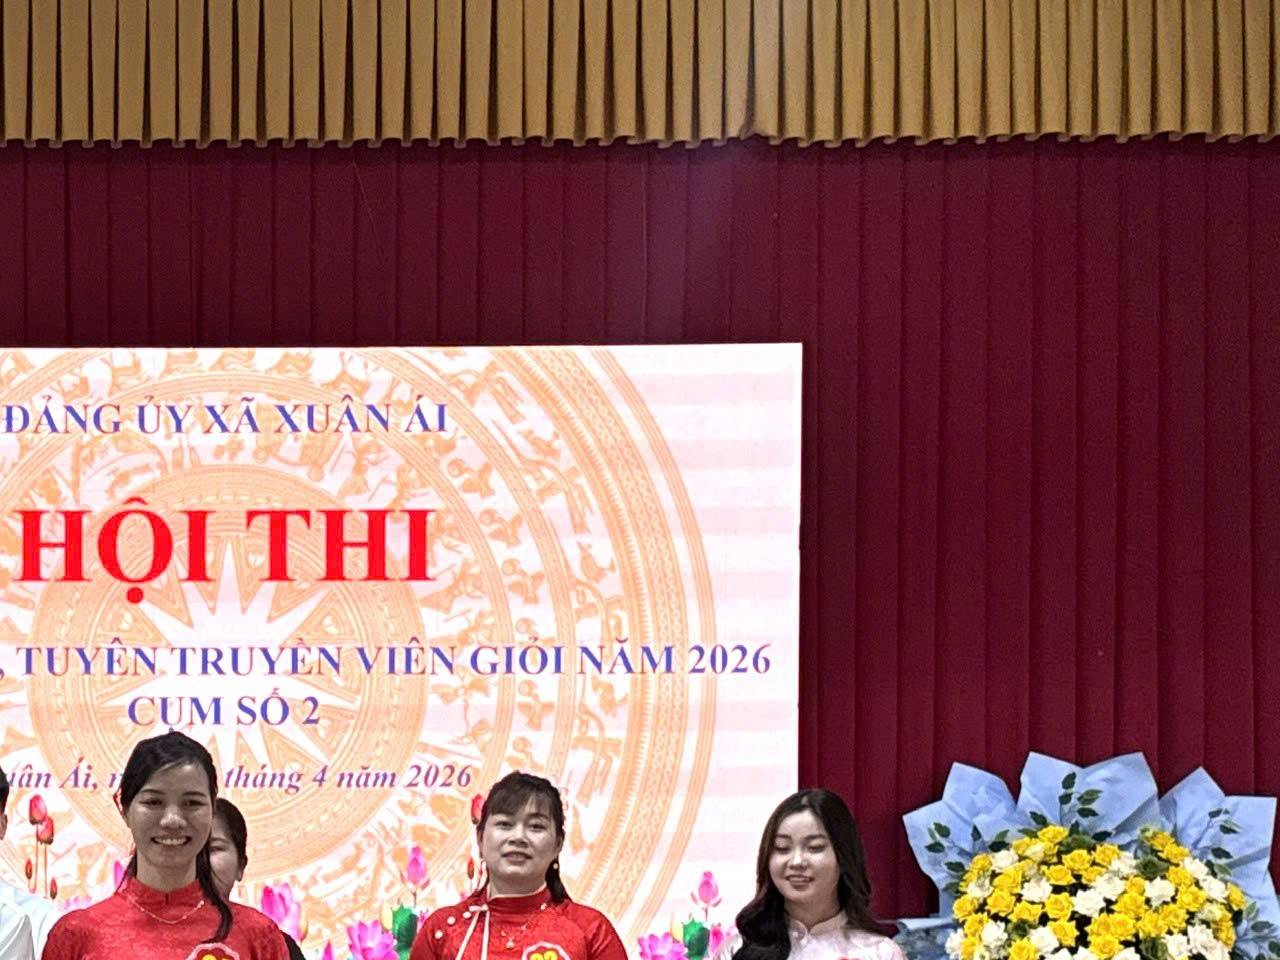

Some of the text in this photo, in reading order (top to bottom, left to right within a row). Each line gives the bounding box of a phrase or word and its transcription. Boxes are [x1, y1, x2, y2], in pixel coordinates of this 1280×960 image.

[2, 394, 448, 434] ĐẢNG ỦY XÃ XUÂN ÁI
[12, 496, 437, 604] HỘI THI
[15, 637, 158, 676] TUYÊN
[171, 637, 341, 676] TRUYỀN
[355, 636, 456, 675] VIÊN
[469, 636, 565, 675] GIỎI
[577, 638, 674, 675] NĂM
[688, 643, 772, 674] 2026
[127, 688, 320, 731] CỤM SỐ 2
[59, 756, 98, 790] Ái,
[224, 764, 472, 794] tháng 4 năm 2026
